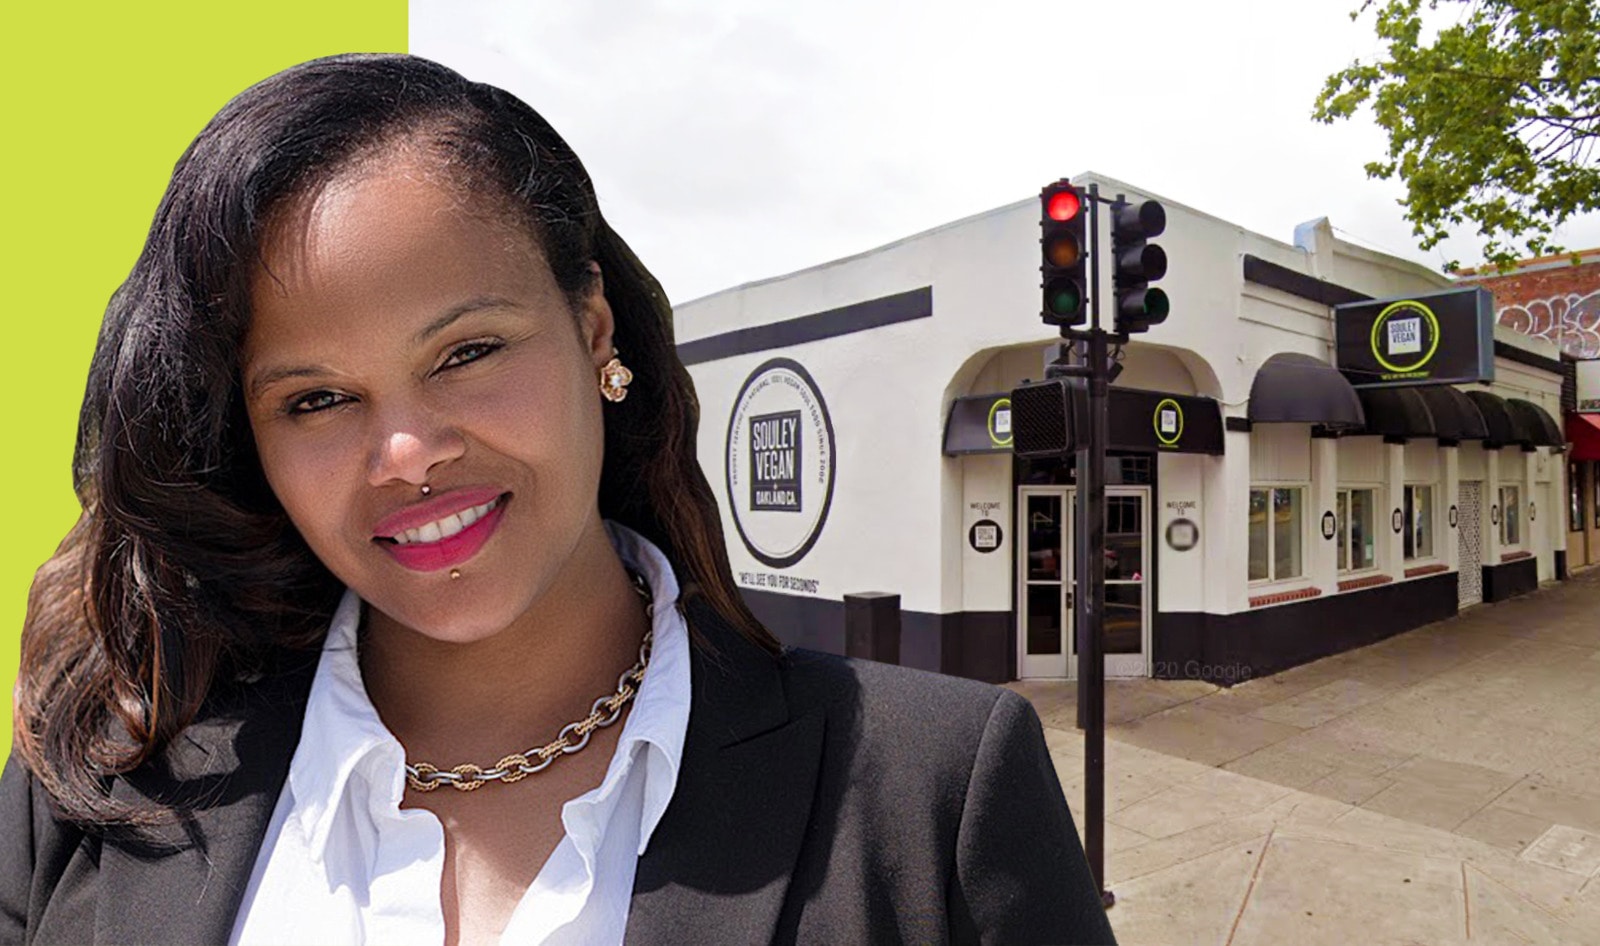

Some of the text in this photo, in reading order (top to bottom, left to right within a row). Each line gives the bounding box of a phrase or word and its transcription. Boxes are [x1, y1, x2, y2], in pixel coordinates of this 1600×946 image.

[1390, 321, 1417, 333] SOULEY
[1392, 332, 1416, 343] VEGAN
[753, 418, 797, 451] SOULEY
[755, 449, 794, 480] VEGAN
[756, 490, 786, 505] OAKLAND
[970, 502, 1001, 510] WELCOME
[1166, 501, 1196, 509] WELCOME
